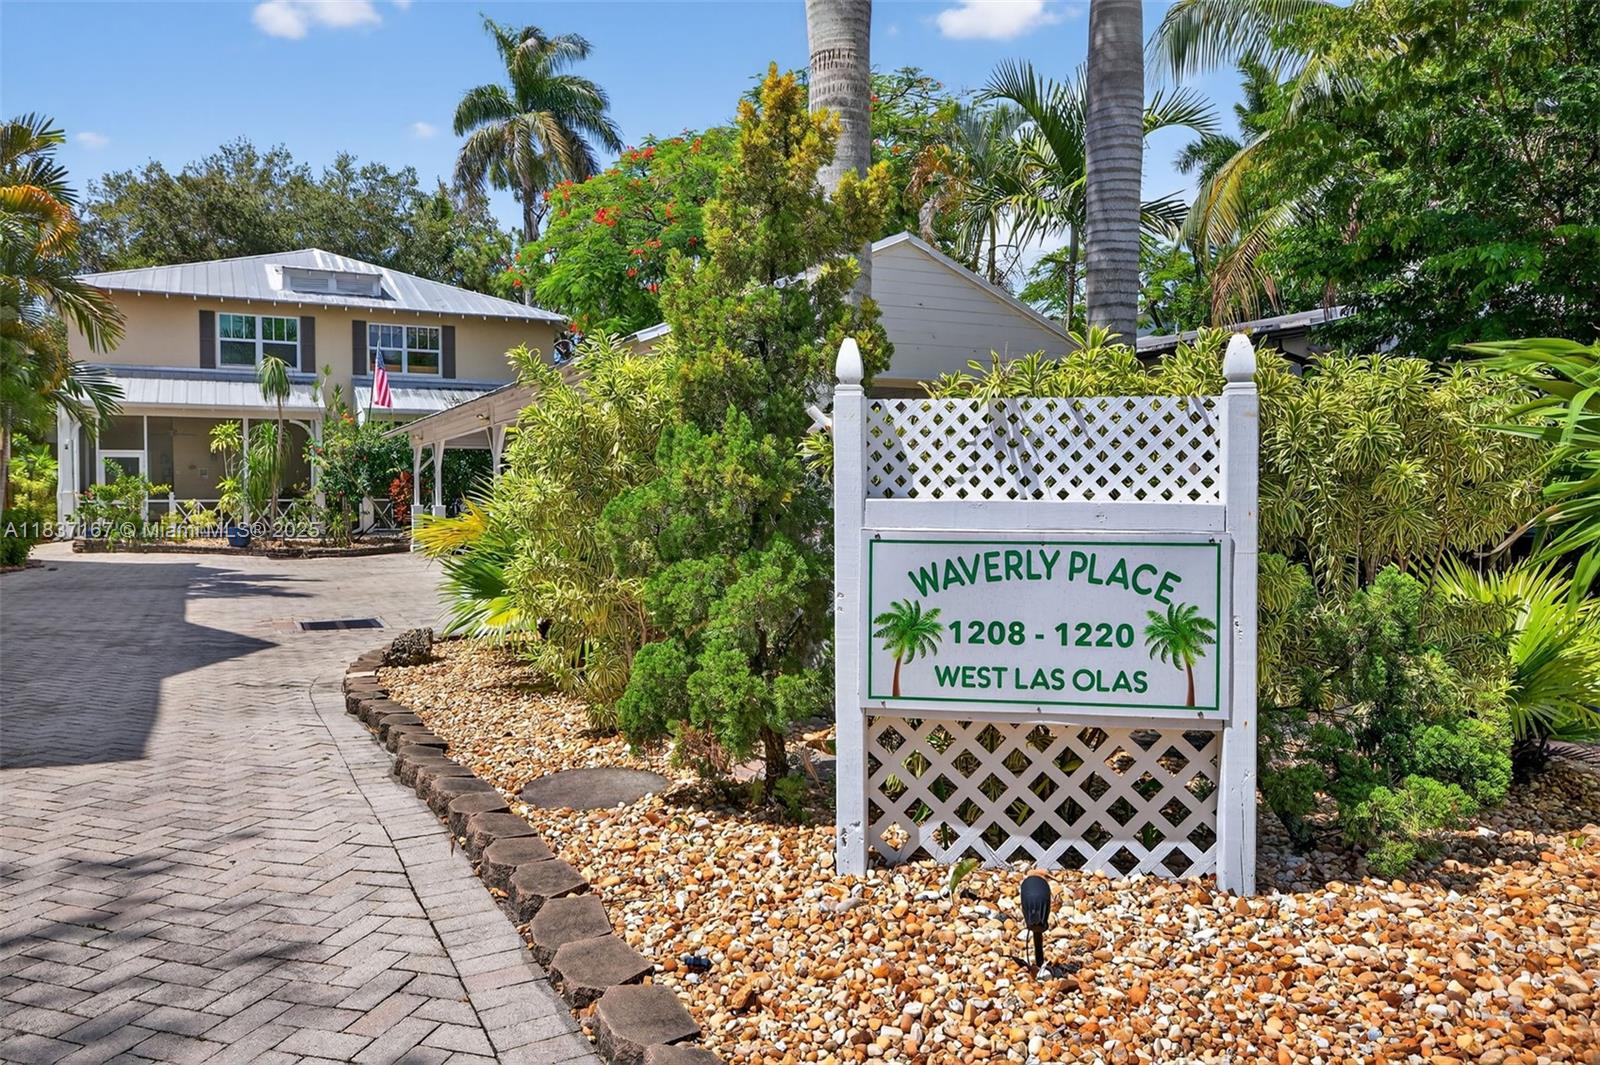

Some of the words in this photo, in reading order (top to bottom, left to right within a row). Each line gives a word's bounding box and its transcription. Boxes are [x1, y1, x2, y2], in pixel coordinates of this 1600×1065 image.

[908, 549, 1061, 597] WAVERLY
[1068, 550, 1182, 606] PLACE
[948, 620, 1026, 646] 1208
[1054, 622, 1135, 648] 1220
[934, 665, 1008, 688] WEST
[1014, 667, 1066, 691] LAS
[1072, 668, 1149, 693] OLAS
